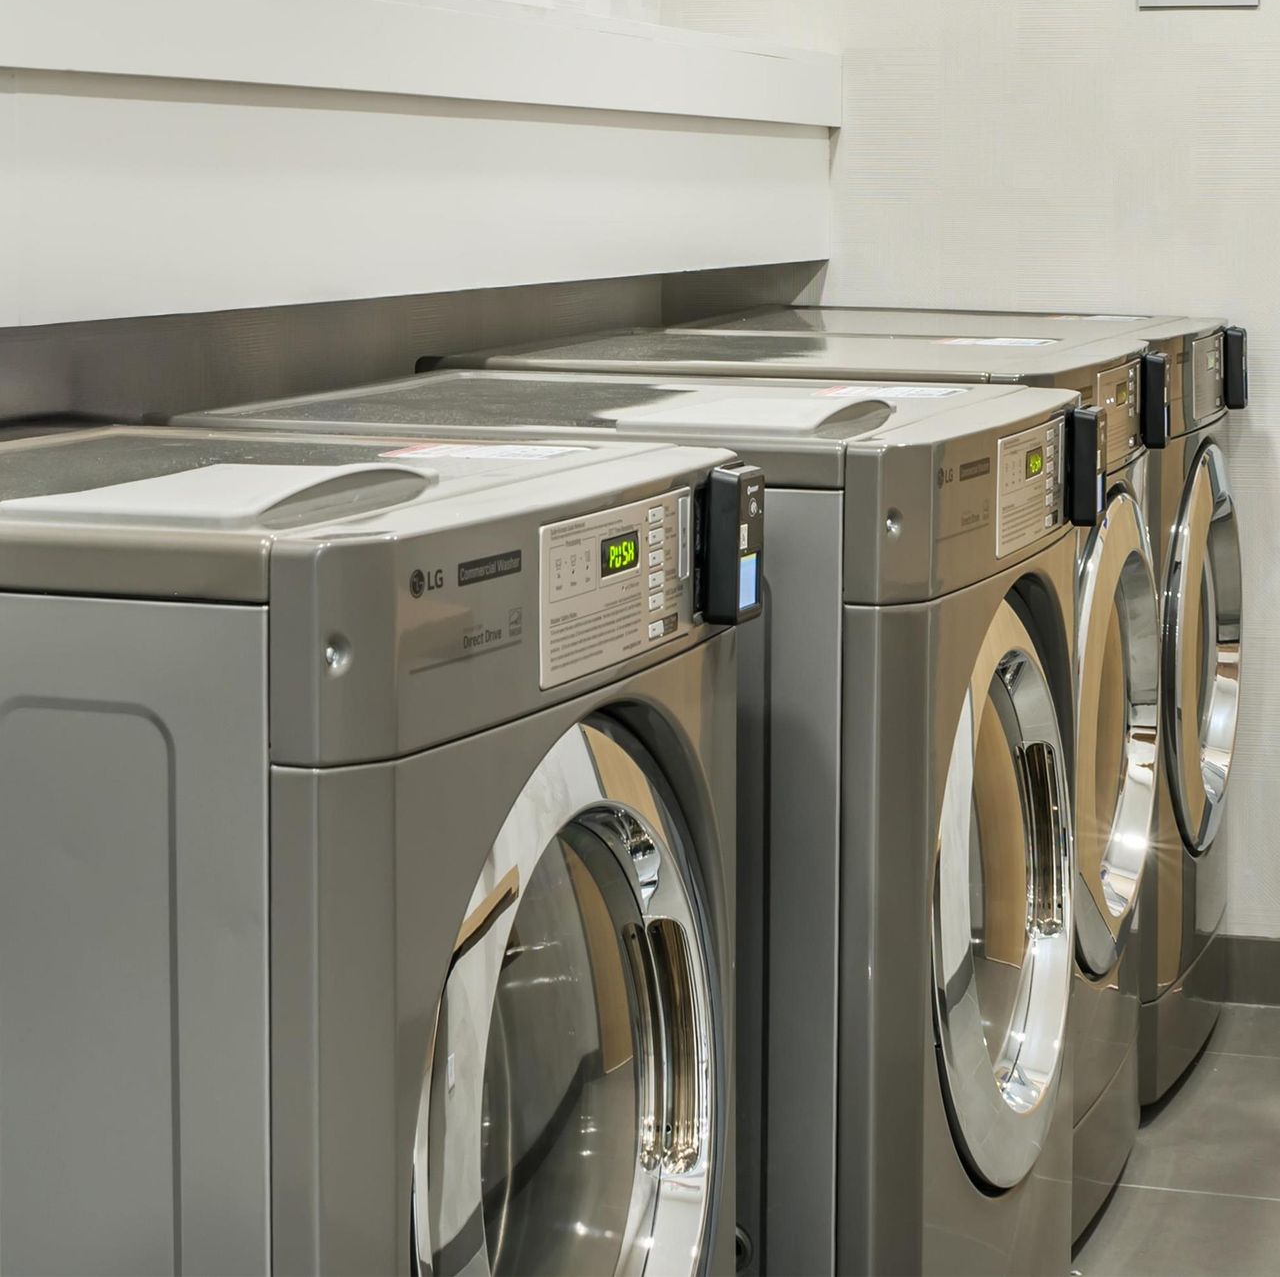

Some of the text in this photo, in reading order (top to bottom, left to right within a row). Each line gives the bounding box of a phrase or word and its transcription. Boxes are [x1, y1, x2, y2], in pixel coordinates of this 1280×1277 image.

[427, 569, 443, 591] LG
[460, 557, 520, 581] Commercial Washer
[463, 632, 484, 649] Direct
[485, 629, 502, 643] Drive
